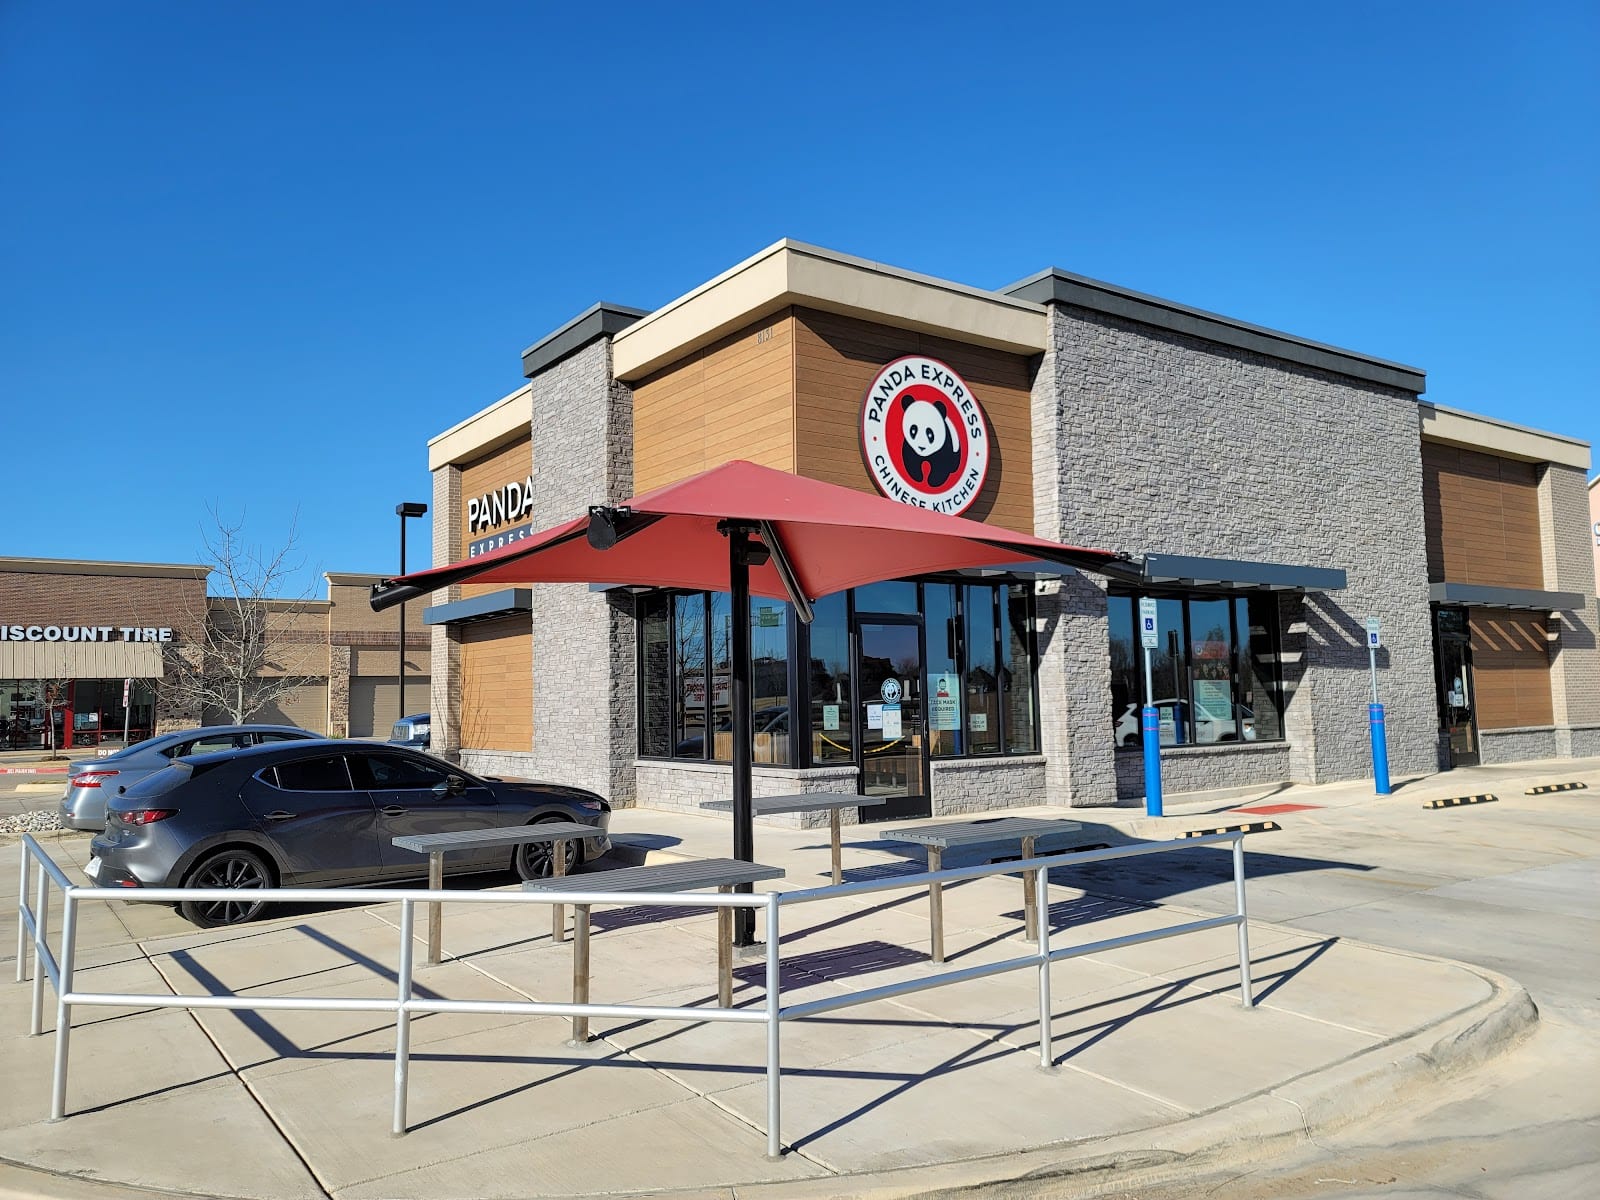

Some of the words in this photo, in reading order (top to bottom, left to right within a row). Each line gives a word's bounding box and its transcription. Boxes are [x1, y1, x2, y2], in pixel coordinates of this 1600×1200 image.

[869, 365, 916, 423] PANDA
[921, 364, 982, 439] EXPRESS
[467, 475, 533, 533] PANDA
[875, 455, 927, 509] CHINESE
[932, 468, 979, 513] KITCHEN
[0, 625, 113, 642] ISCOUNT
[119, 627, 173, 642] TIRE
